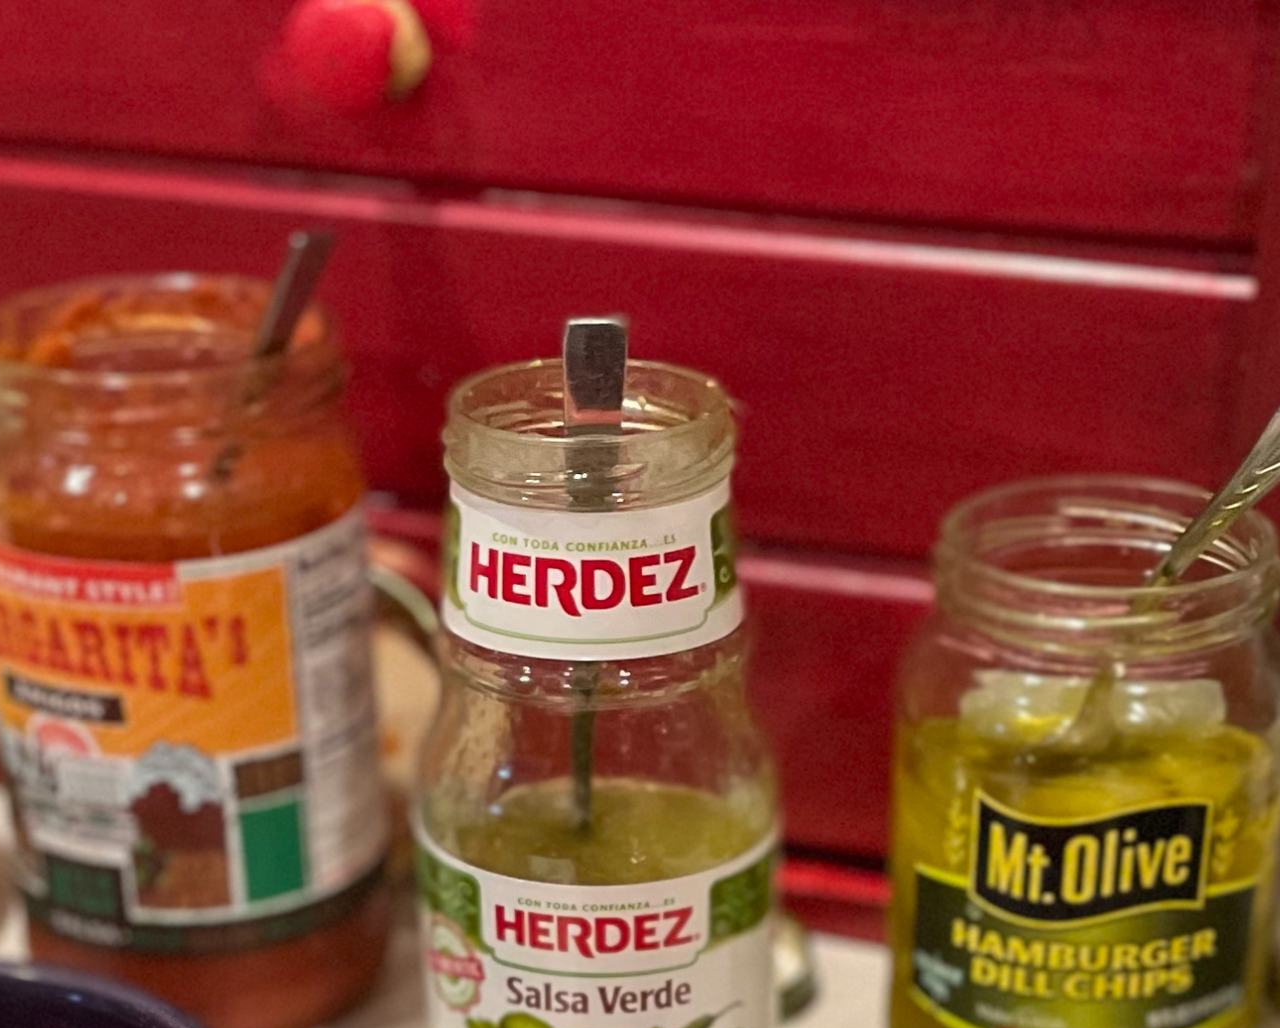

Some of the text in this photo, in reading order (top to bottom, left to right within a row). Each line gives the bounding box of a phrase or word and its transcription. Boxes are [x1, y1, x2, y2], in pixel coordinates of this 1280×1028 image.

[492, 532, 518, 546] CON
[523, 538, 559, 551] TODA
[470, 541, 699, 617] HERDEZ
[1061, 827, 1193, 905] Olive
[517, 897, 542, 908] CON
[495, 904, 694, 959] HERDEZ
[951, 918, 1218, 971] HAMBURGER
[506, 976, 692, 1014] Salsa Verde
[970, 956, 1054, 998] DILL
[1063, 963, 1194, 1000] CHIPS
